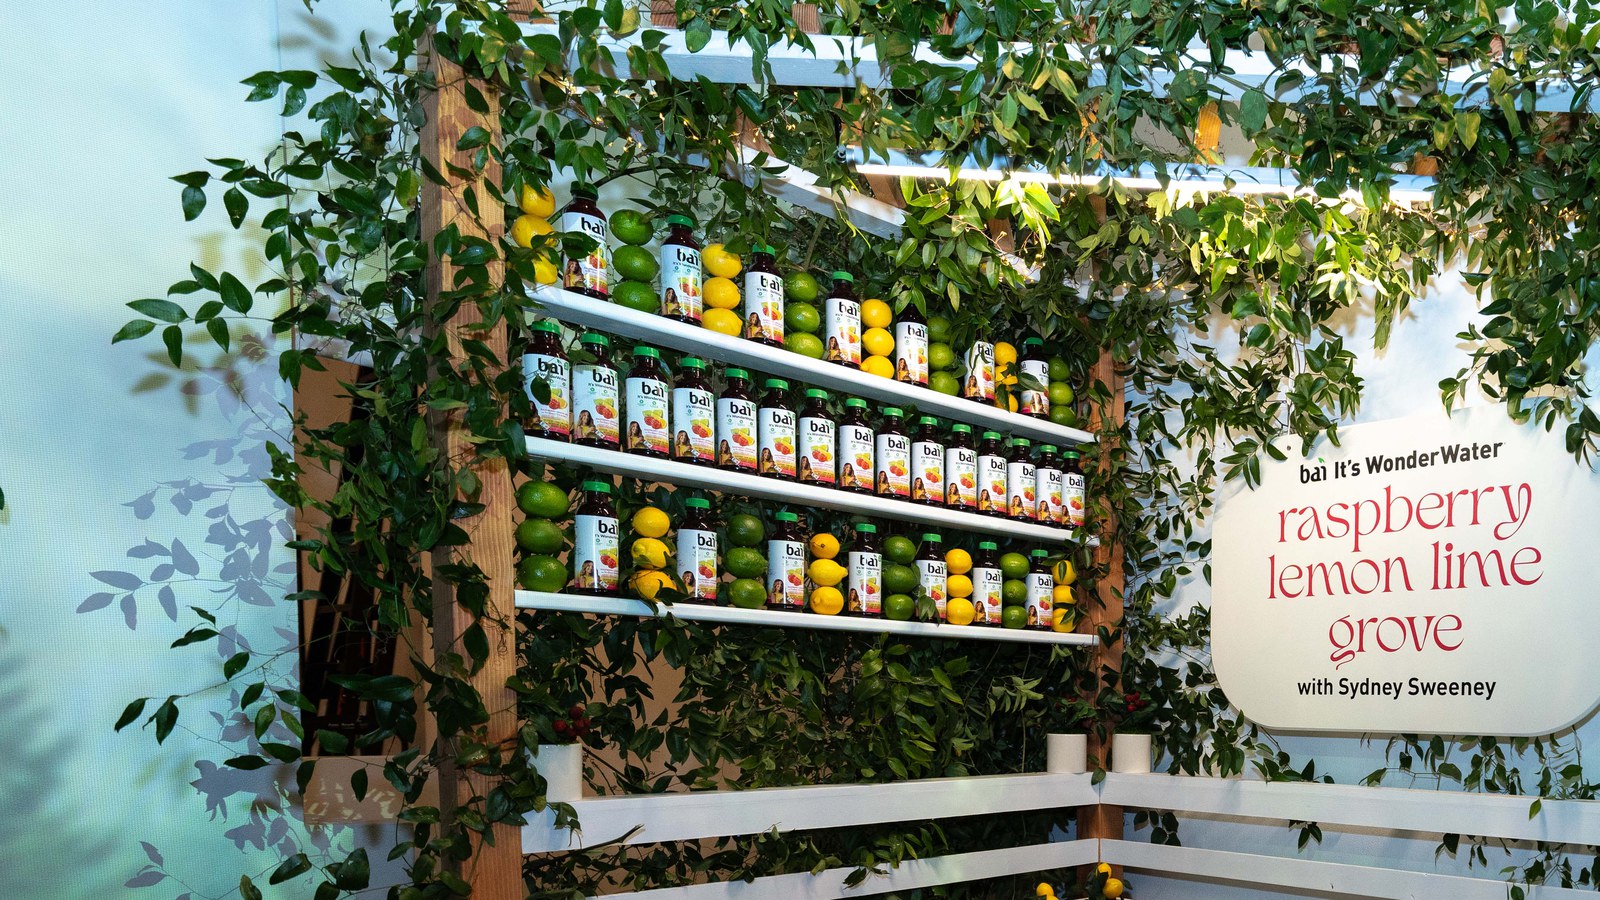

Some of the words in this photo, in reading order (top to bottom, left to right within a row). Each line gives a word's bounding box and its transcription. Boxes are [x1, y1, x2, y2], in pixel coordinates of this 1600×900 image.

[538, 358, 564, 376] bai
[592, 369, 615, 387] bai
[641, 382, 664, 398] bai
[689, 392, 710, 407] bai
[730, 402, 751, 416] bai
[772, 412, 793, 426] bai
[810, 421, 829, 434] bai
[854, 429, 872, 443] bai
[888, 437, 906, 450] bai
[924, 445, 941, 457] bai
[958, 452, 975, 463] bai
[990, 459, 1006, 470] bai
[1300, 457, 1327, 484] bai
[1334, 459, 1360, 480] It's
[1366, 442, 1503, 475] WonderWater
[1069, 477, 1083, 487] bai
[1278, 482, 1532, 552] raspberry
[598, 520, 618, 534] bai
[697, 534, 716, 546] bai
[786, 543, 803, 557] bai
[927, 563, 944, 575] bai
[1268, 555, 1414, 599] lemon
[1430, 541, 1544, 590] lime
[1329, 614, 1464, 670] grove
[1298, 677, 1334, 696] with
[1338, 677, 1403, 700] Sydney
[1408, 677, 1496, 701] Sweeney
